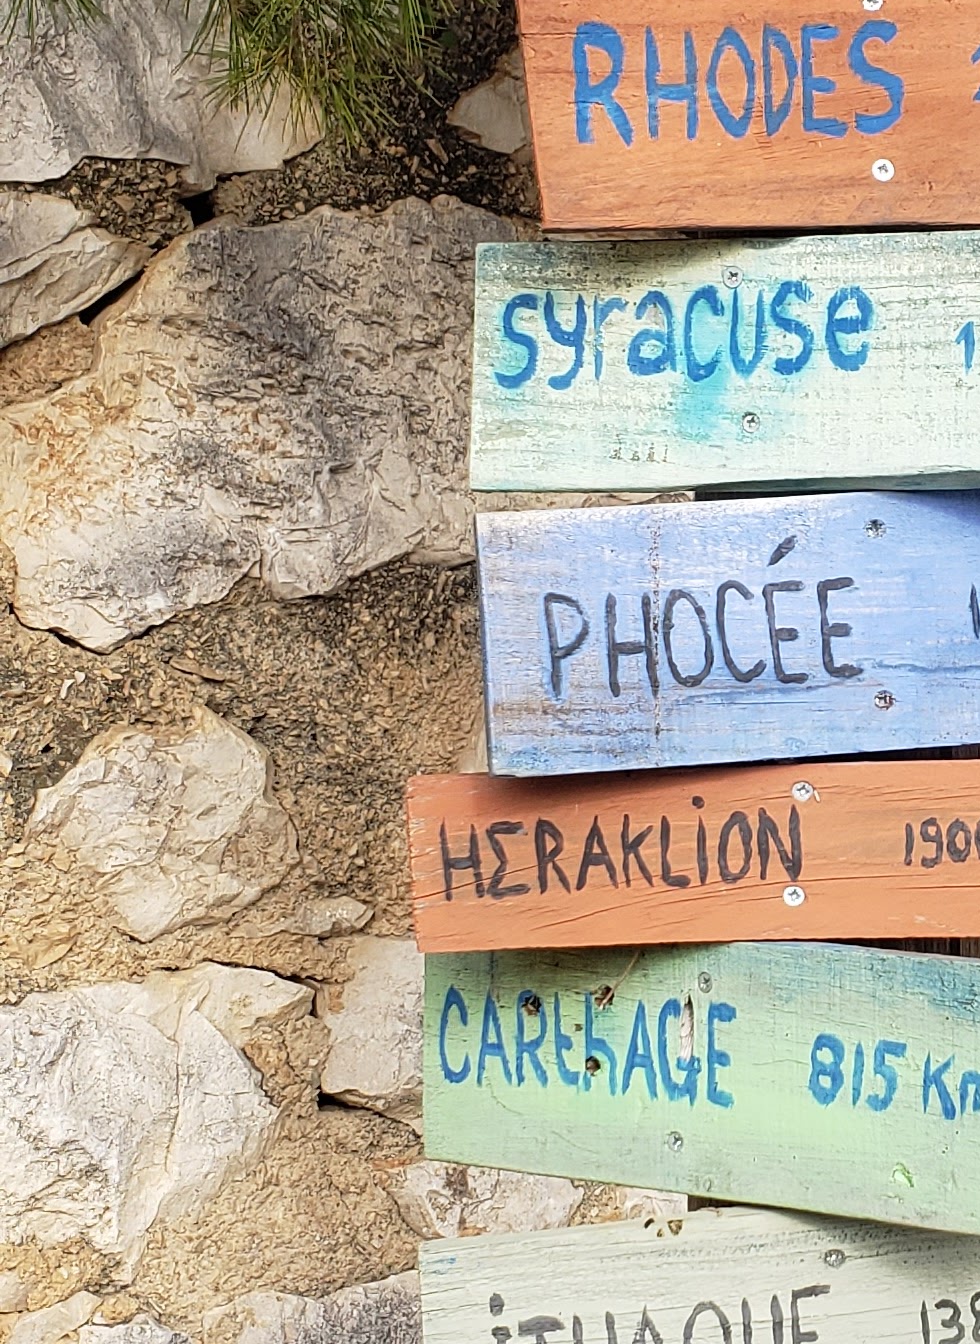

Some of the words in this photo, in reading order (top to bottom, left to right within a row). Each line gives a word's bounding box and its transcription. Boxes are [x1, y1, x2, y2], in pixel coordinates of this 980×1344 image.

[572, 18, 905, 147] RHODES
[542, 535, 865, 701] PHOCÉE
[807, 1033, 908, 1113] 815
